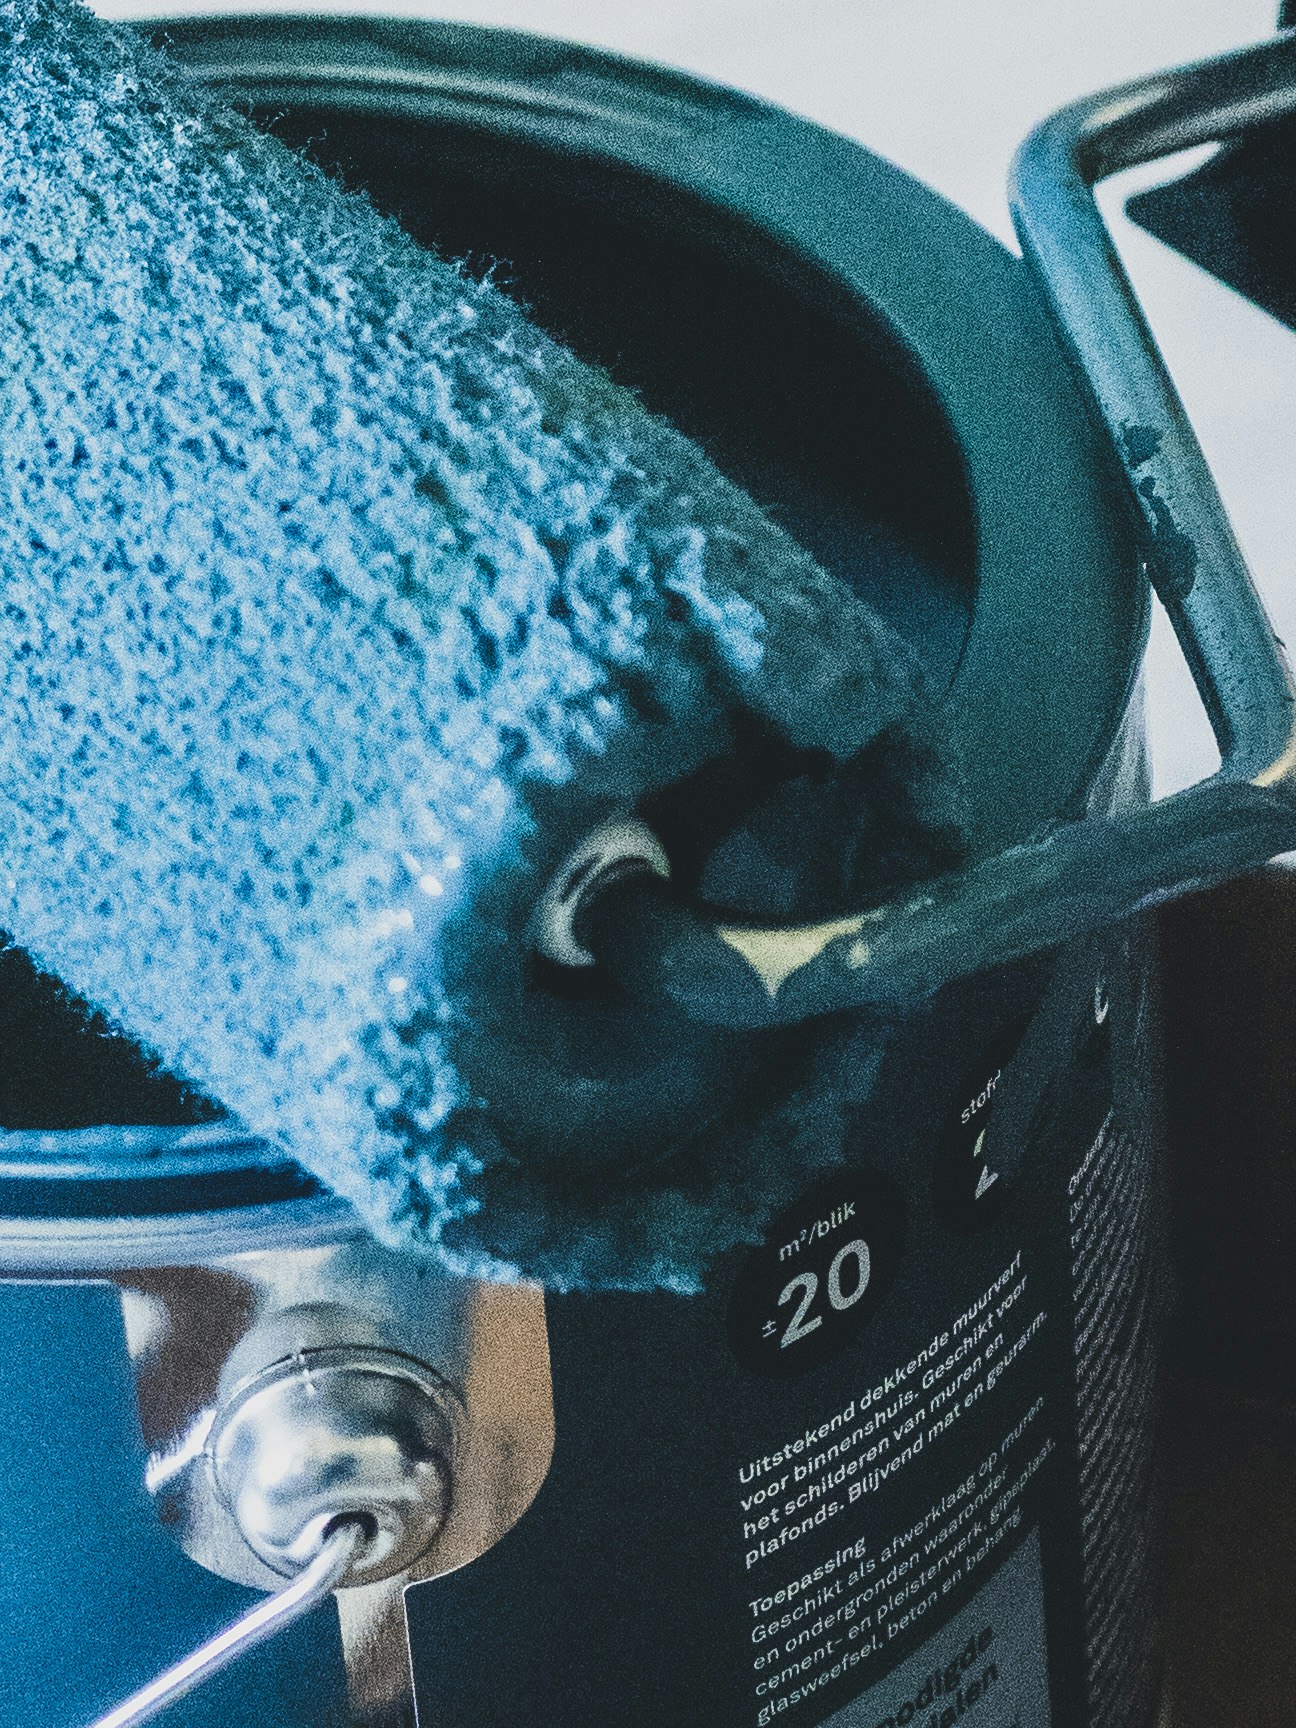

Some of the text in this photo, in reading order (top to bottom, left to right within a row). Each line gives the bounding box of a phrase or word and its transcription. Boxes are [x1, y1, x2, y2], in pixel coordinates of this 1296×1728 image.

[739, 1249, 1022, 1484] Uitstekend dekkende muurverf
[740, 1274, 1028, 1512] voor binnenshuis. Geschikt voor
[743, 1332, 1004, 1539] het schilderen van muren en
[745, 1310, 1048, 1570] plafonds. Blijvend mat en geurarm.
[748, 1535, 866, 1617] Toepassing
[751, 1395, 1044, 1644] Geschikt als afwerklaag op muren
[753, 1647, 780, 1670] en
[784, 1551, 920, 1654] ondergronden
[887, 1590, 938, 1641] beton
[942, 1569, 962, 1594] en
[755, 1638, 843, 1696] cement-
[848, 1615, 872, 1640] en
